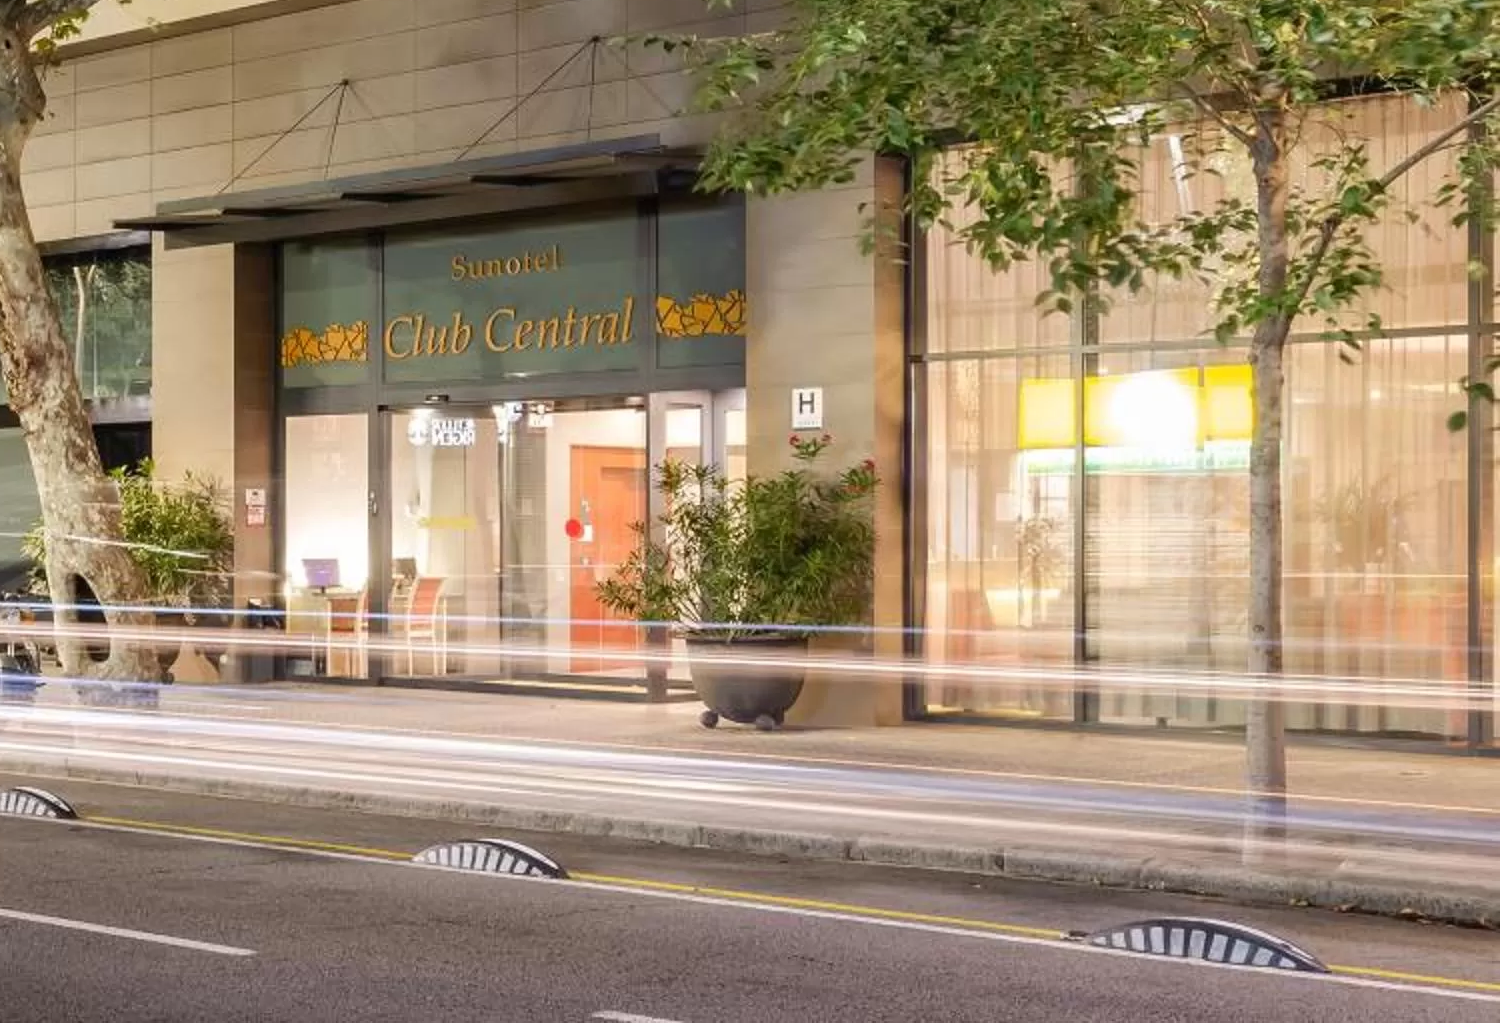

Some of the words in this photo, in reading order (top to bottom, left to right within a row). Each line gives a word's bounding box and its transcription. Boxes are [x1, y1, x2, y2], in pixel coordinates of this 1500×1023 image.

[451, 244, 561, 281] Sunotel
[384, 310, 473, 359] Club
[485, 294, 636, 353] Central
[799, 392, 815, 414] H
